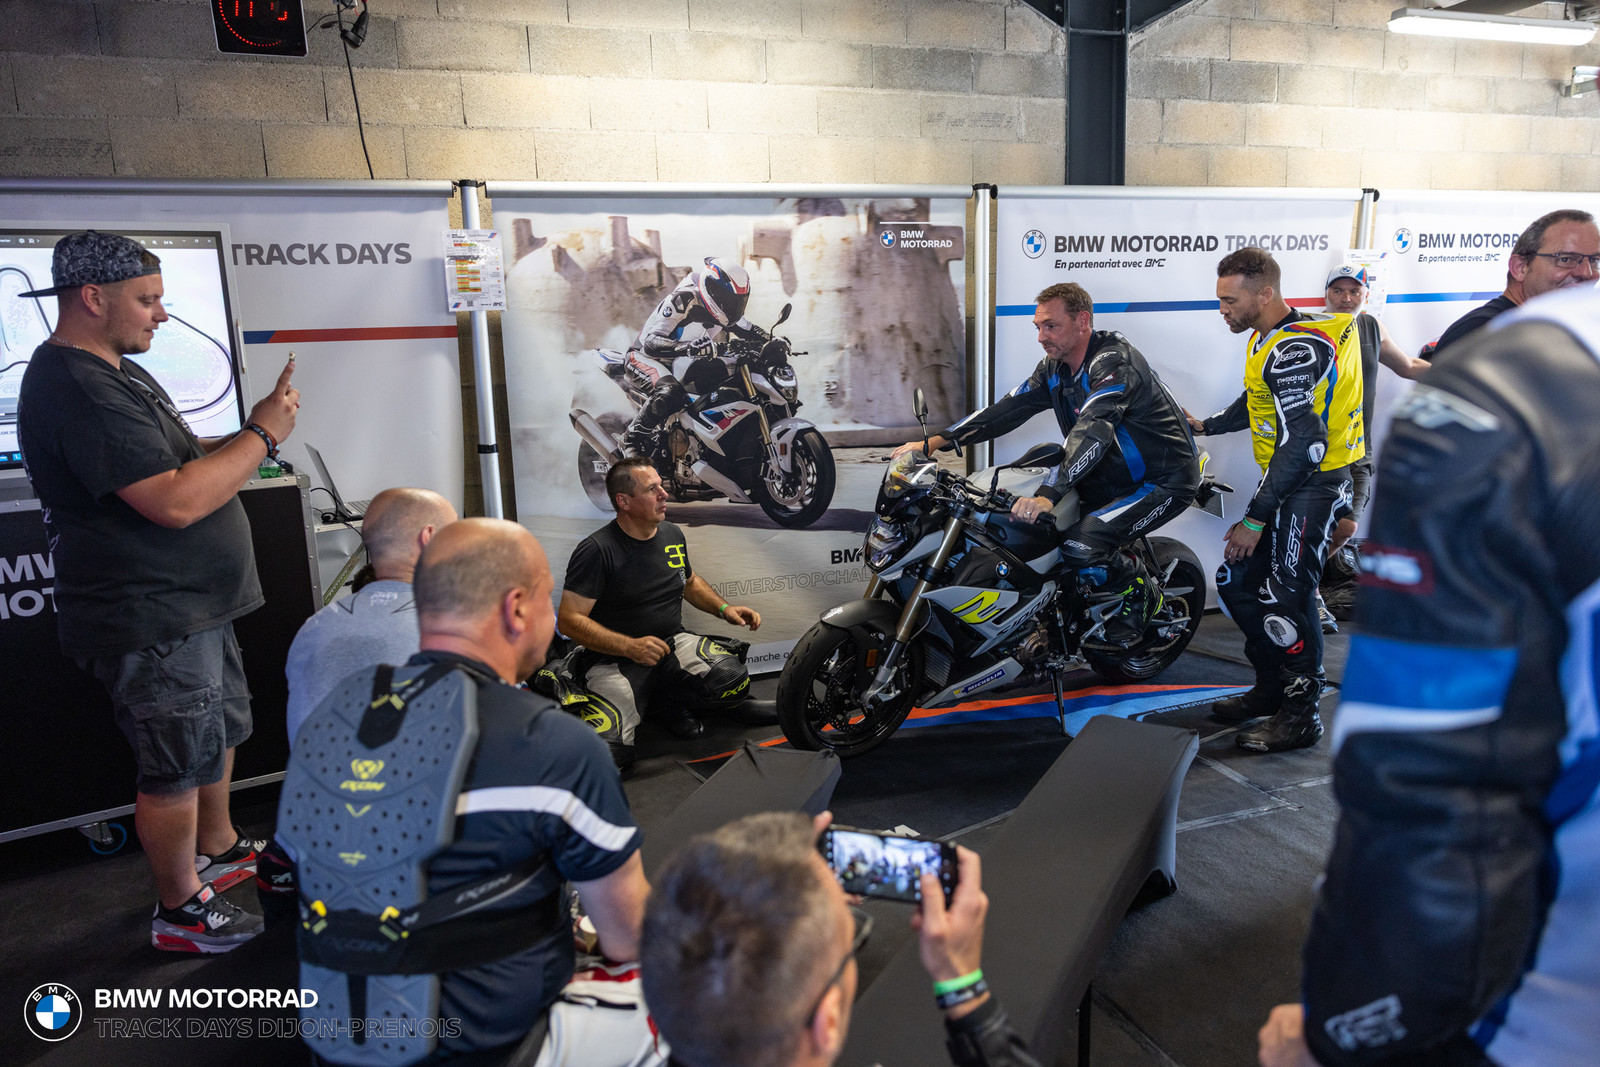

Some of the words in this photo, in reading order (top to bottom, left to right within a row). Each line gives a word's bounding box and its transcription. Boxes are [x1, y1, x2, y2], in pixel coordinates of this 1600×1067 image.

[900, 230, 924, 239] BMW
[900, 240, 953, 248] MOTORRAD
[1054, 235, 1105, 253] BMW
[1111, 235, 1219, 252] MOTORRAD
[1225, 234, 1284, 251] TRACK
[1286, 234, 1329, 251] DAYS
[1418, 233, 1455, 248] BMW
[231, 243, 330, 266] TRACK
[335, 243, 412, 265] DAYS
[1418, 254, 1428, 263] En
[1428, 253, 1467, 264] partenariat
[1054, 259, 1067, 269] En
[1068, 258, 1121, 271] partenariat
[1122, 260, 1143, 268] avec
[1068, 441, 1099, 483] RST
[1128, 496, 1173, 536] RST
[1284, 513, 1303, 578] RST
[967, 670, 1003, 692] MICHELIN
